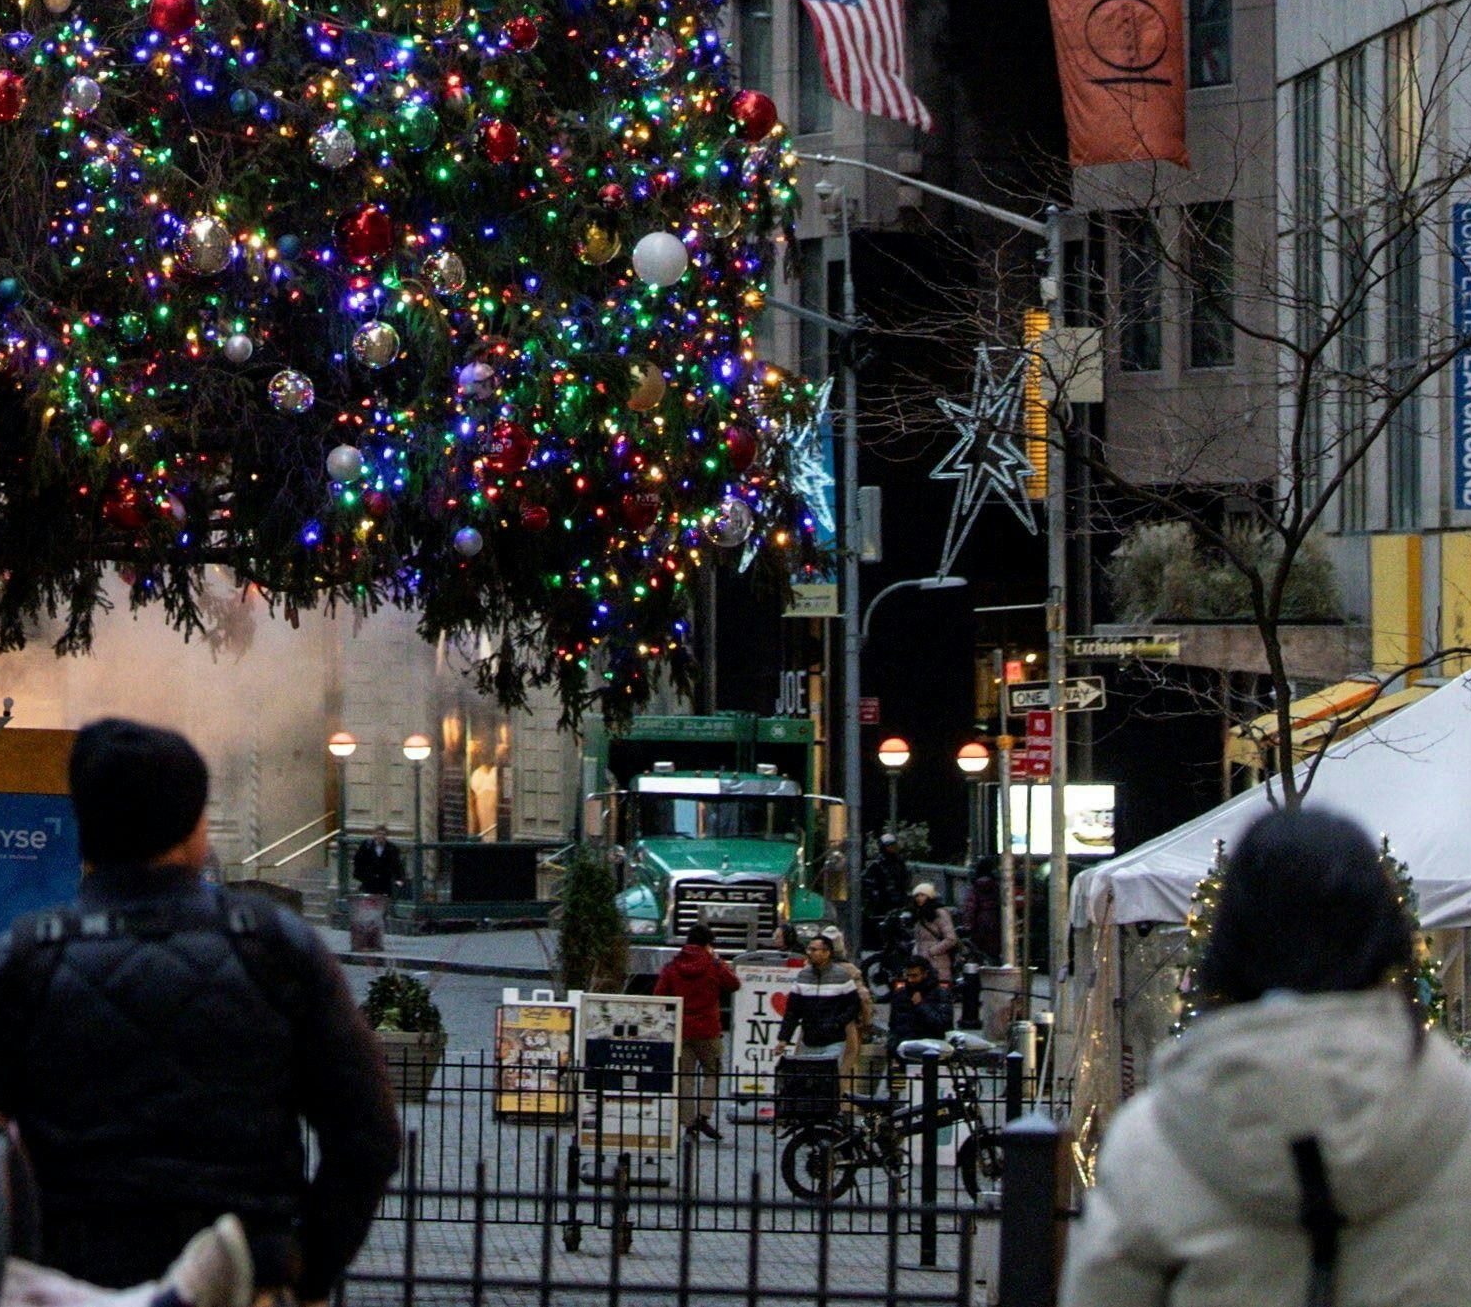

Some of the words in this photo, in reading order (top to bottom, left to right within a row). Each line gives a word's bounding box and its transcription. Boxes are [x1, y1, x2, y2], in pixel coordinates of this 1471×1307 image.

[1073, 640, 1133, 659] Exchange
[775, 670, 807, 715] JOE
[1016, 690, 1045, 705] ONE
[684, 890, 768, 902] MACK
